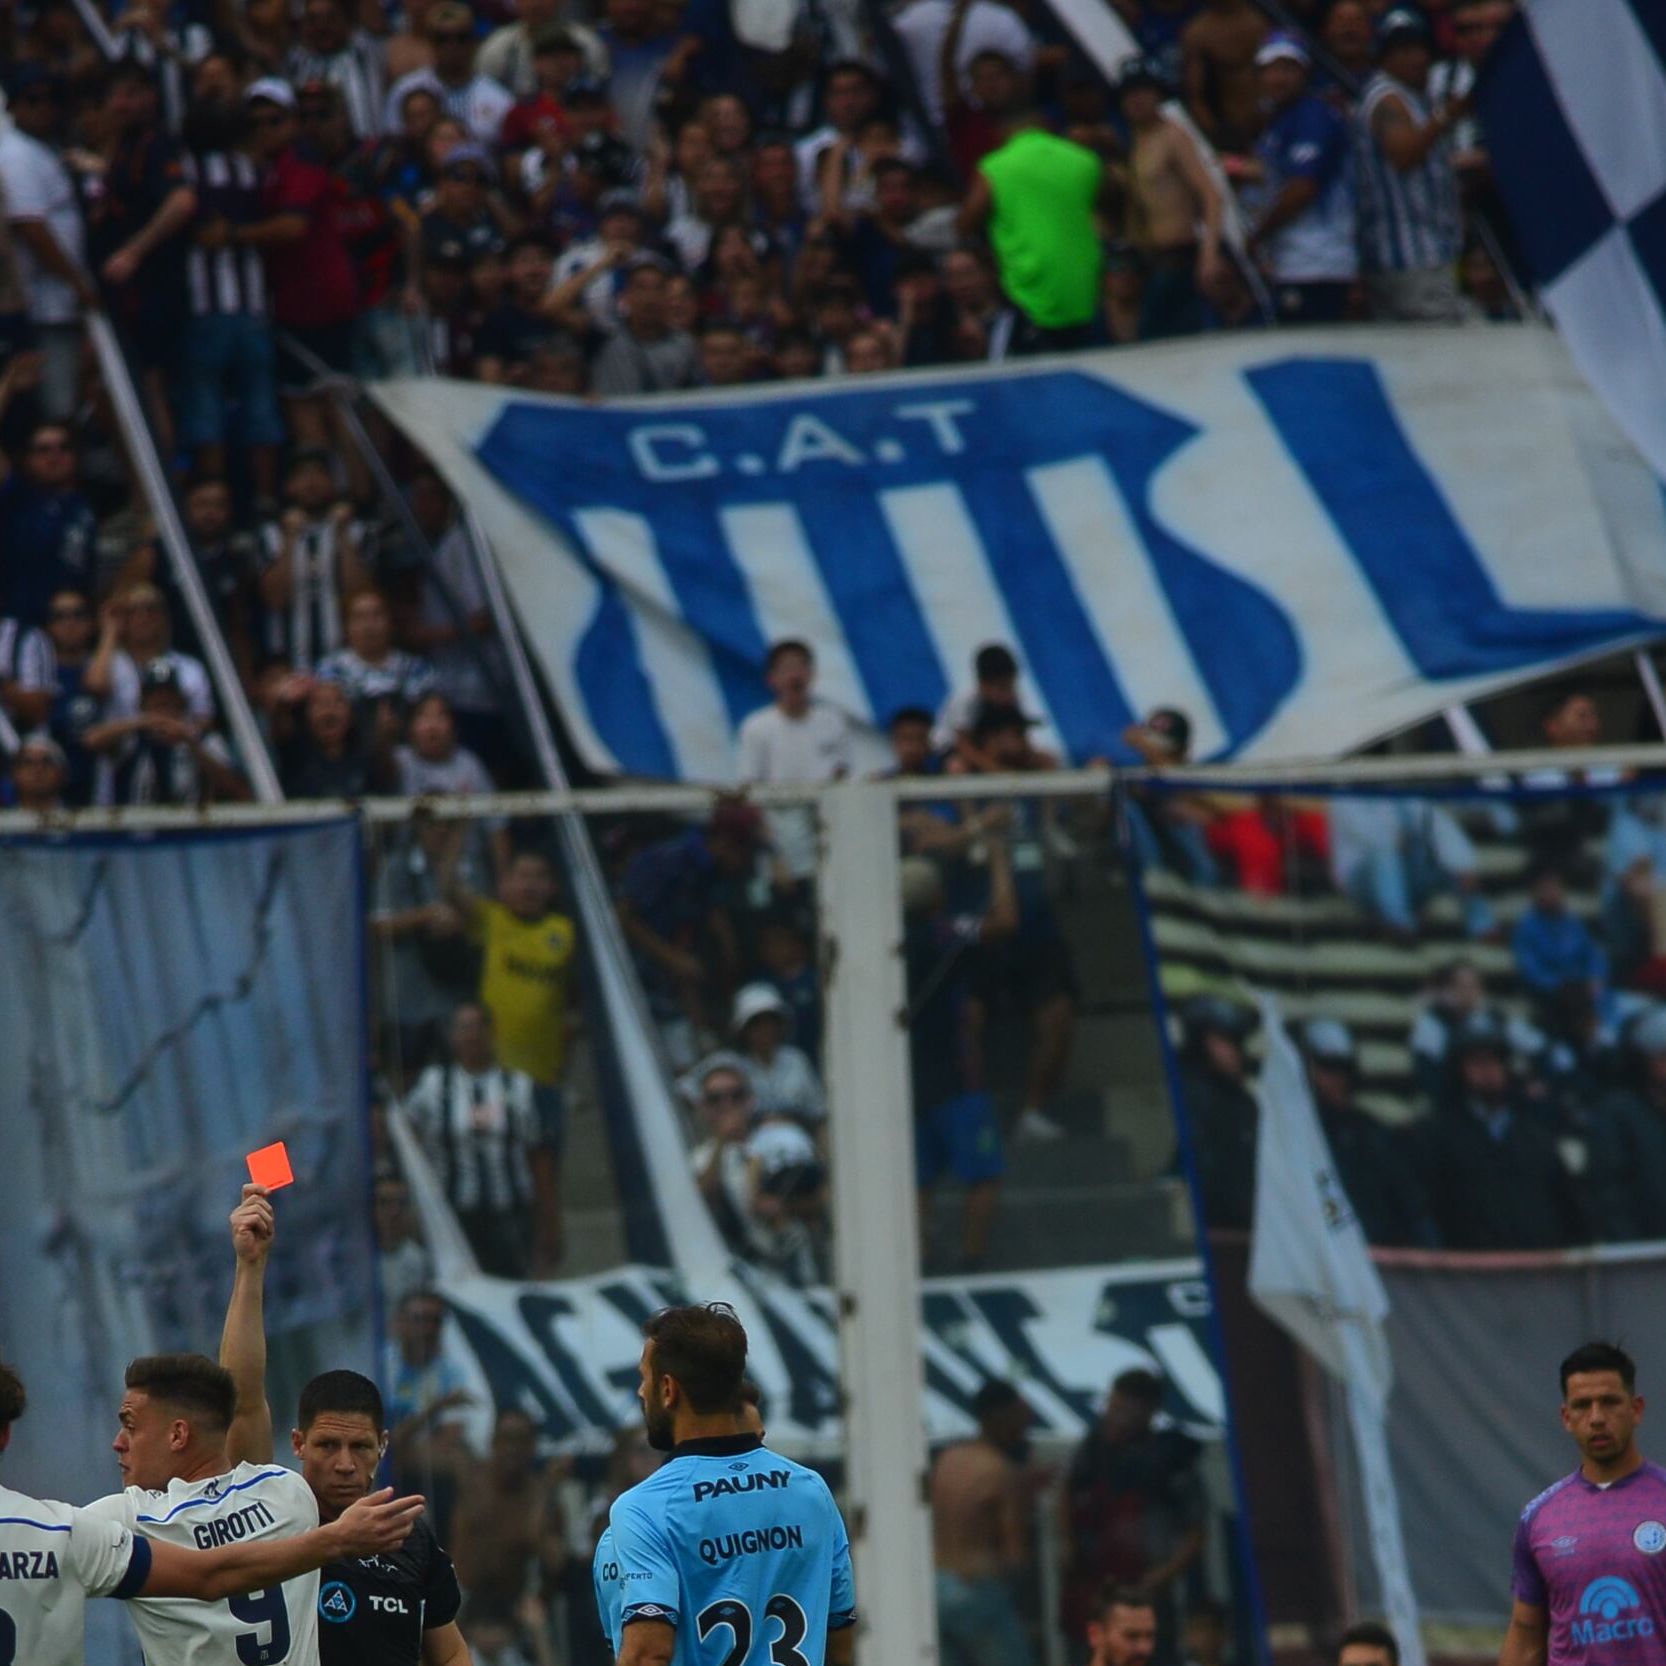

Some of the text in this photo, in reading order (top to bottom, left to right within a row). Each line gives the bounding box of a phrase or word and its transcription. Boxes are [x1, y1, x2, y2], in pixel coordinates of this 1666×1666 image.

[693, 1470, 791, 1503] PAUNY
[193, 1502, 275, 1550] GIROTTI
[699, 1525, 803, 1566] QUIGNON
[367, 1594, 410, 1615] TCL
[1569, 1617, 1655, 1647] Macro
